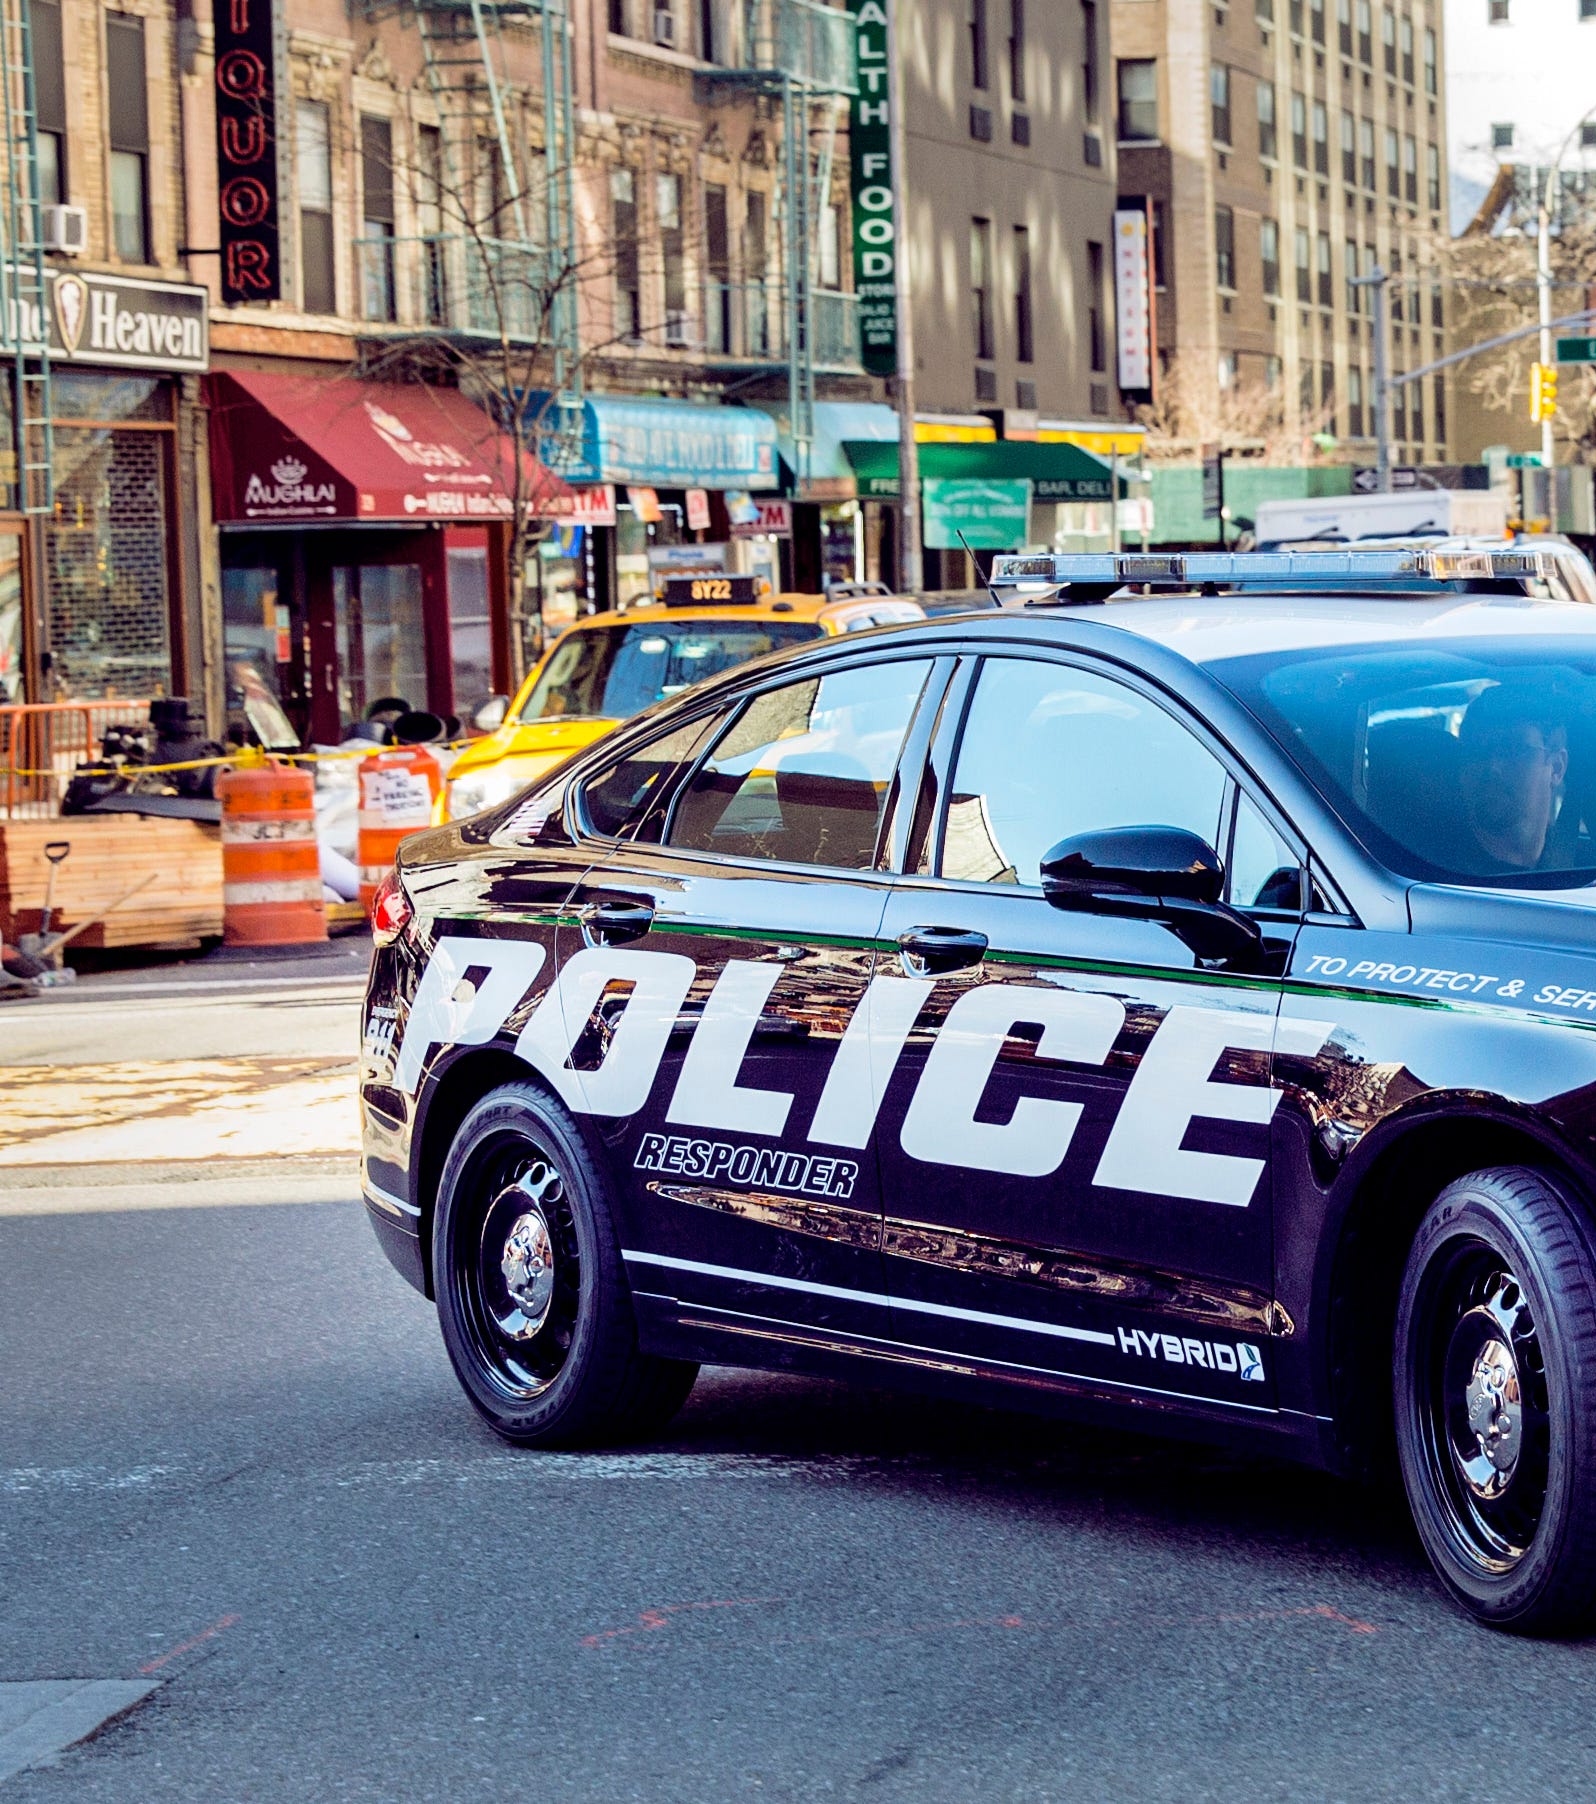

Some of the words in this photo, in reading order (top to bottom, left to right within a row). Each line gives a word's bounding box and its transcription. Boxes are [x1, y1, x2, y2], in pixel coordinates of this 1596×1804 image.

[859, 153, 894, 277] FOOD
[90, 290, 201, 357] Heaven
[245, 473, 336, 504] MUGHLAI
[1304, 955, 1348, 976] TO
[1346, 960, 1499, 994] PROTECT
[1496, 978, 1526, 999] &
[397, 936, 1336, 1207] POLICE
[633, 1132, 859, 1199] RESPONDER
[1117, 1326, 1238, 1373] HYBRID
